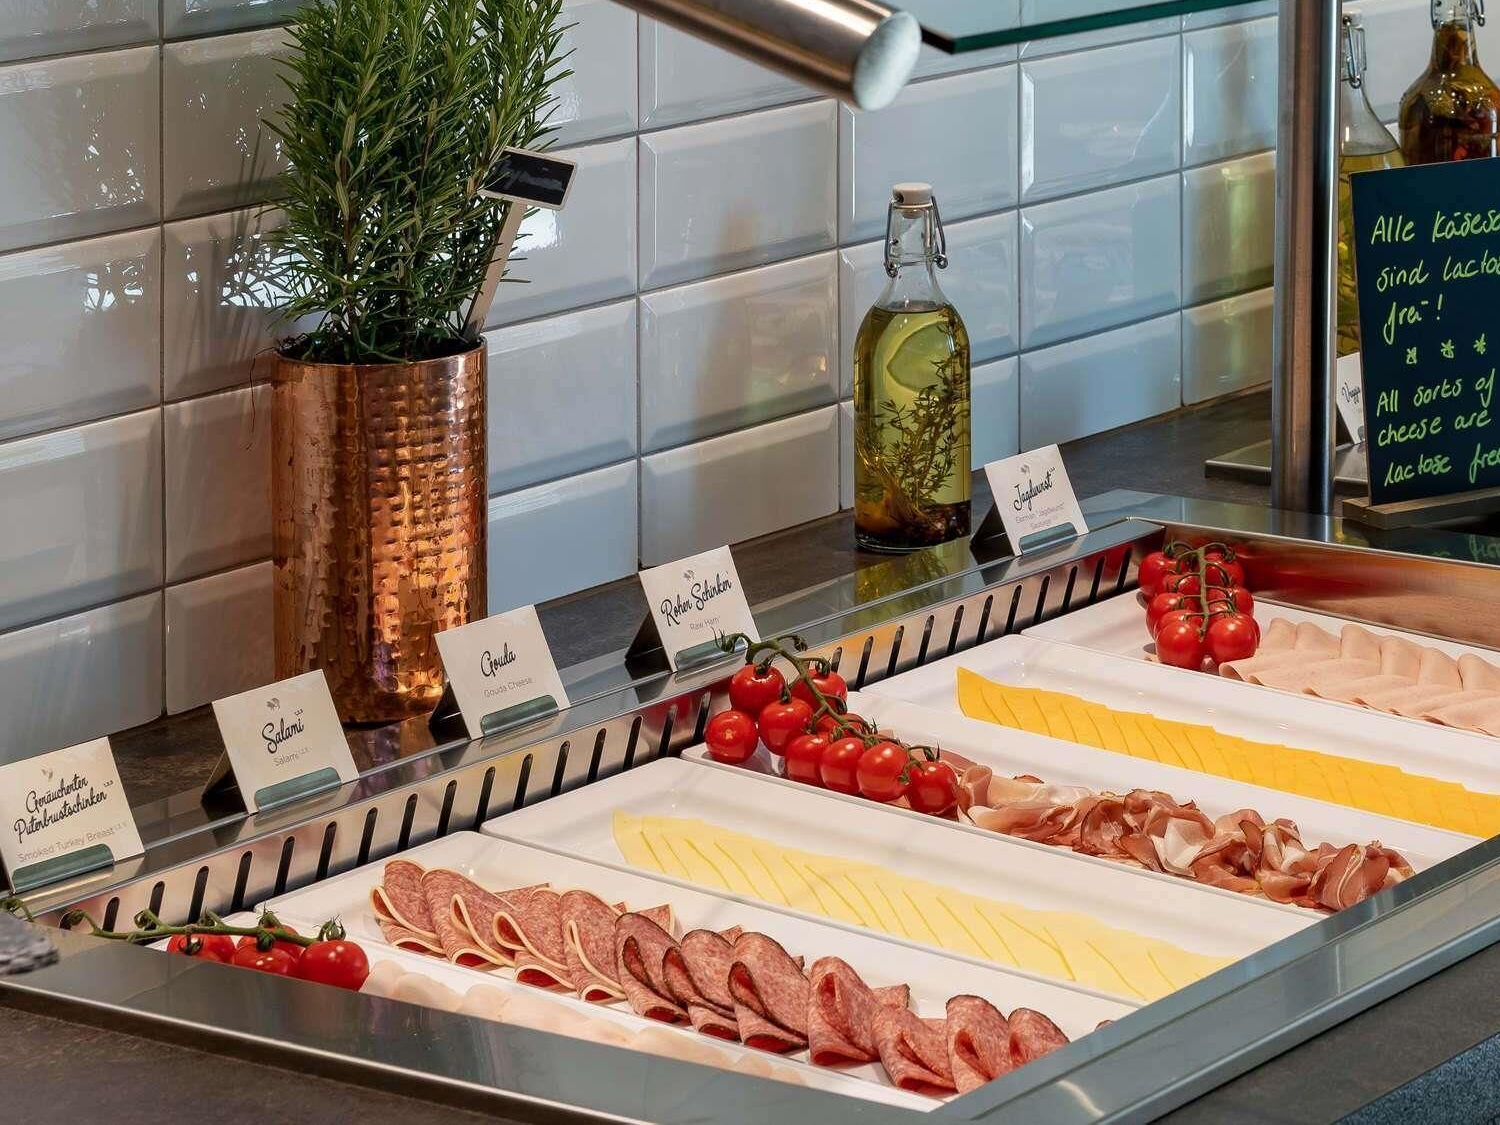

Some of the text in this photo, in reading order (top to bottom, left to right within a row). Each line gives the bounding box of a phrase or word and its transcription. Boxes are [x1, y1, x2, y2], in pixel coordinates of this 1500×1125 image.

[1371, 214, 1415, 245] Alle
[1377, 260, 1430, 293] sind
[1376, 367, 1497, 418] All sorts of
[1378, 408, 1493, 447] cheese are
[1384, 455, 1452, 488] lactose
[661, 573, 732, 627] Roher Schinken
[481, 643, 517, 678] Gouda
[483, 677, 534, 698] Gouda Cheese
[262, 718, 305, 755] Salami
[273, 753, 299, 767] Salami
[25, 774, 89, 814] Geräucherter
[13, 787, 108, 844] Putenbrustschinken
[18, 828, 115, 863] Smoked Turkey Breast
